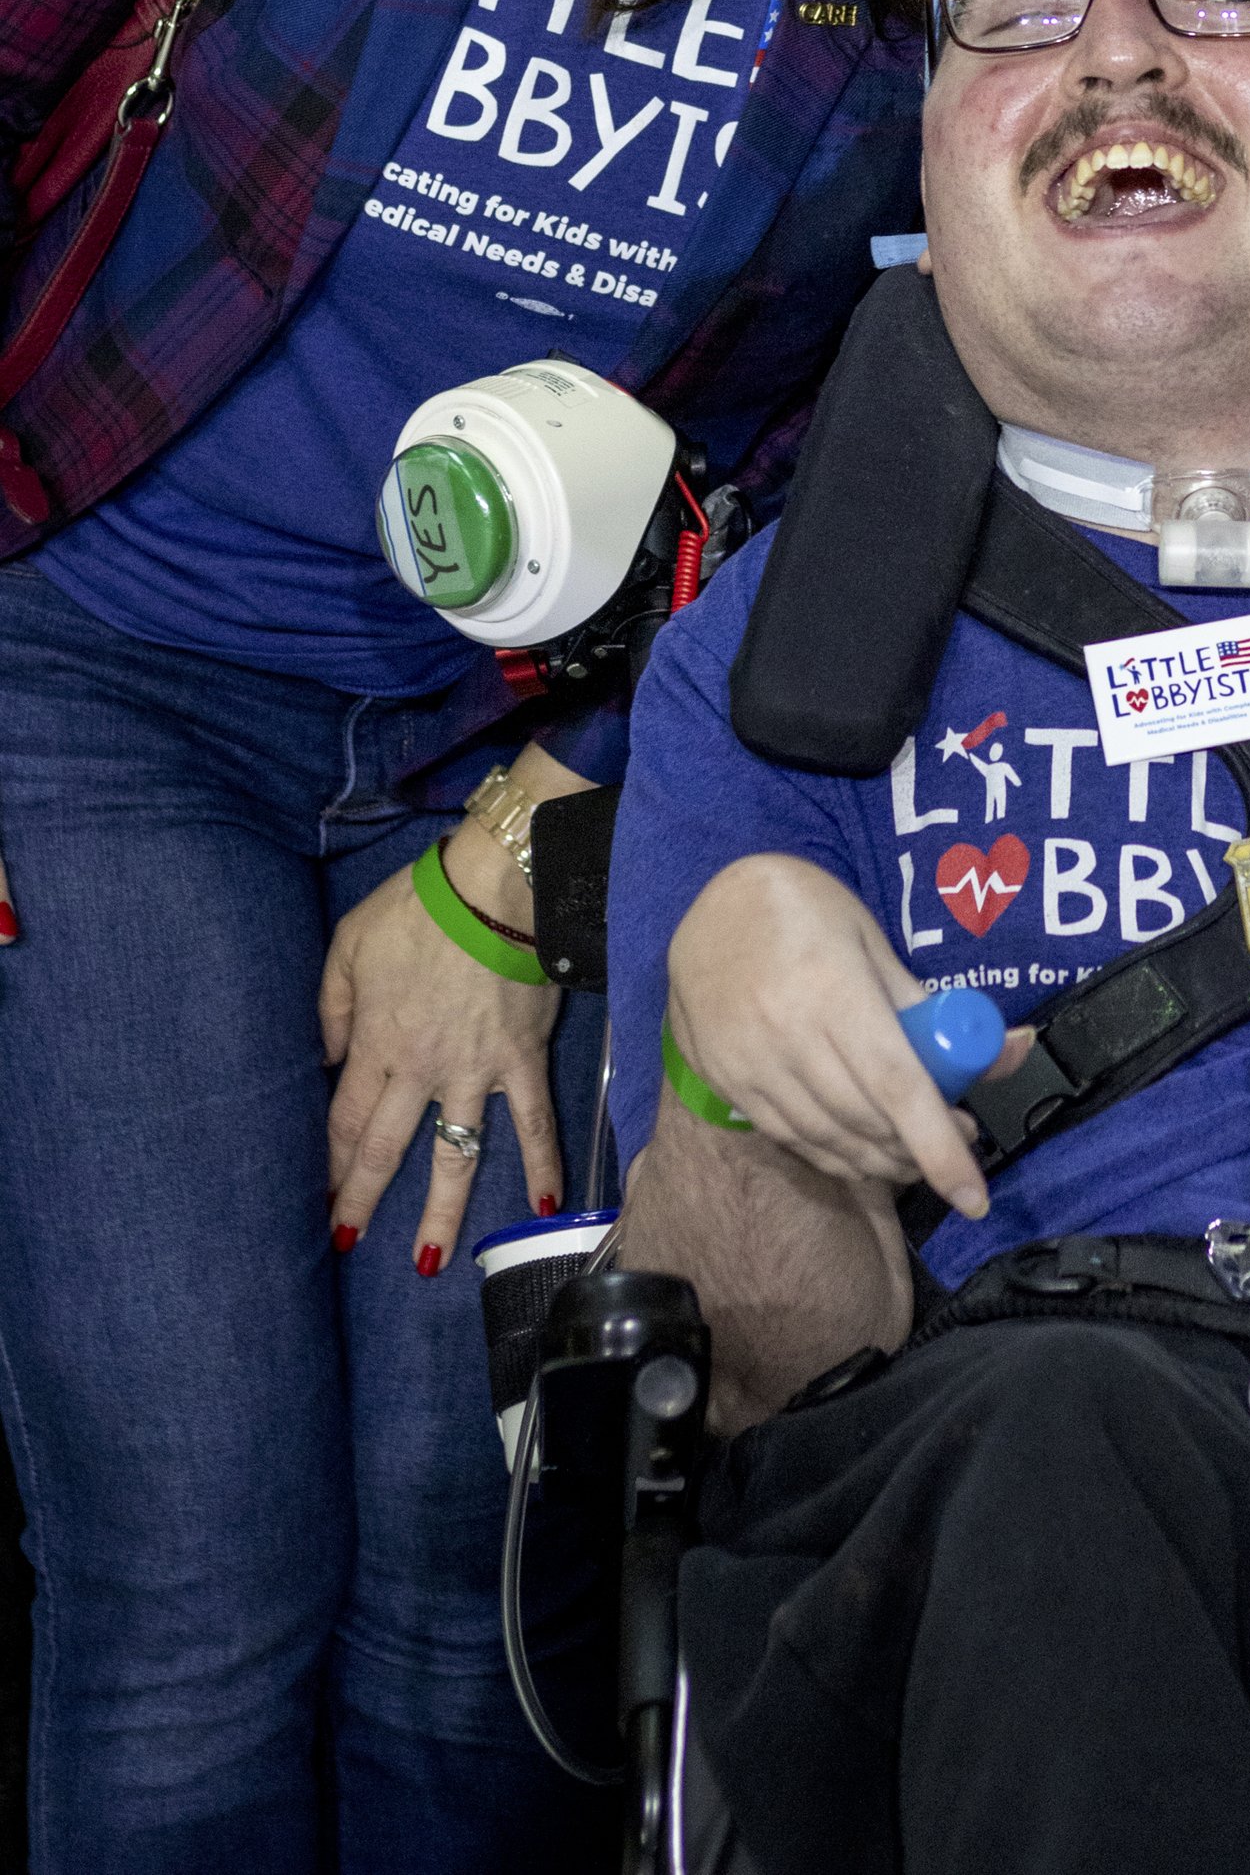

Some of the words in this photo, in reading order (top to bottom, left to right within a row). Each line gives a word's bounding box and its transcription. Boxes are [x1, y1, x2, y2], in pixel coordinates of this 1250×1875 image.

[364, 199, 460, 246] edical
[461, 230, 559, 278] Needs
[565, 263, 585, 287] &
[591, 270, 658, 307] Disa
[484, 195, 530, 226] for
[532, 211, 602, 250] Kids
[609, 238, 677, 272] with
[407, 482, 459, 584] YES
[1028, 963, 1069, 984] for
